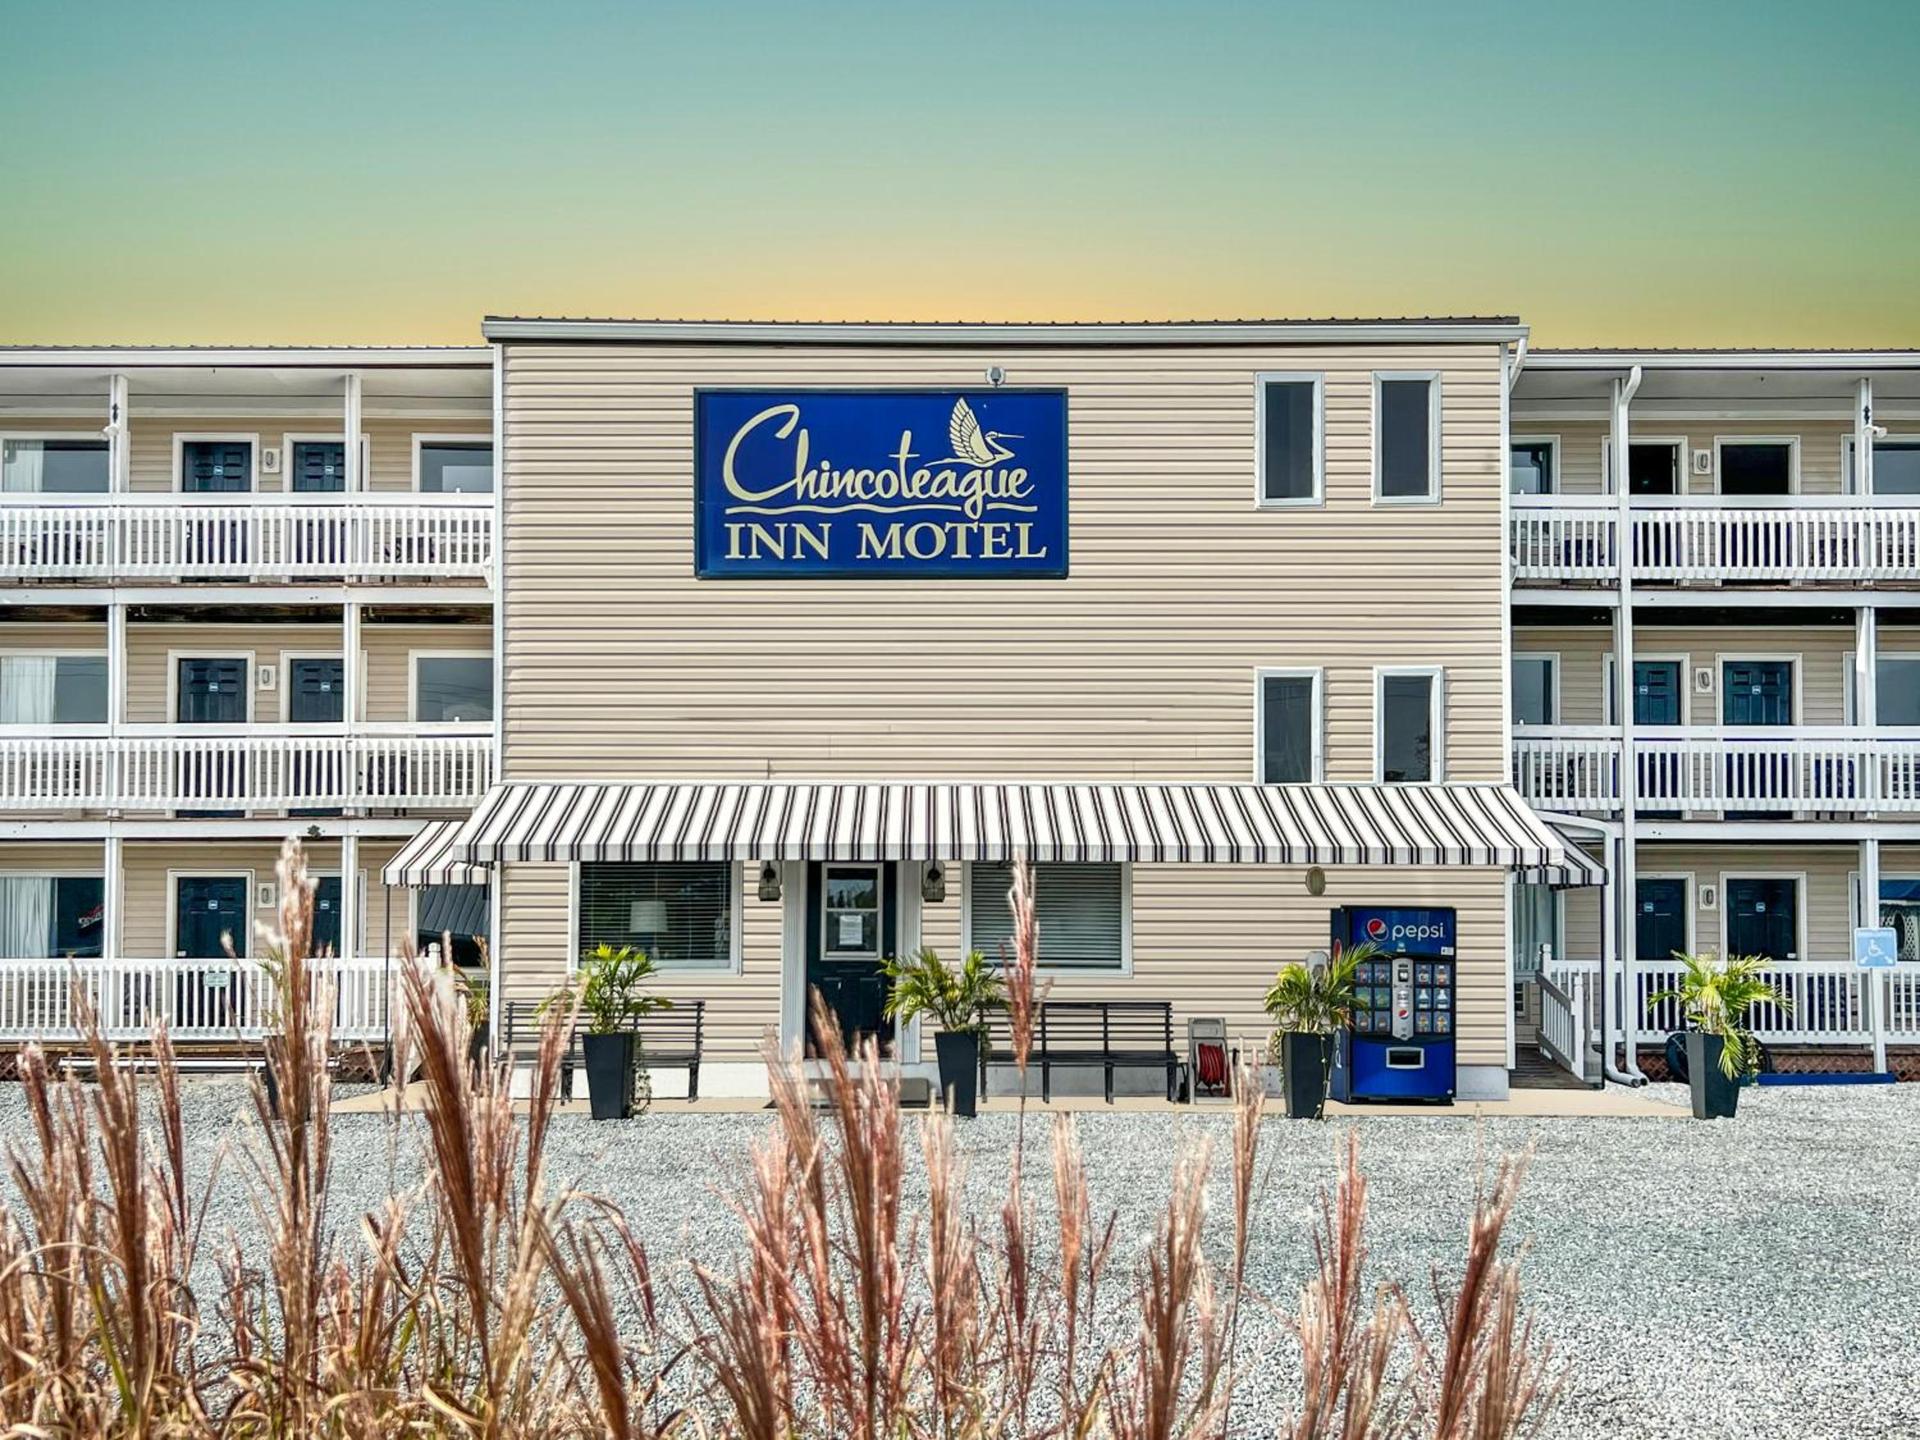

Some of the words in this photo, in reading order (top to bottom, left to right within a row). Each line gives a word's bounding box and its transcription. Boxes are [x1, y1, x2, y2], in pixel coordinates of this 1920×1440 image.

[722, 403, 1035, 519] Chincoteague
[724, 522, 832, 560] INN
[856, 522, 1047, 560] MOTEL
[1392, 922, 1444, 941] pepsi
